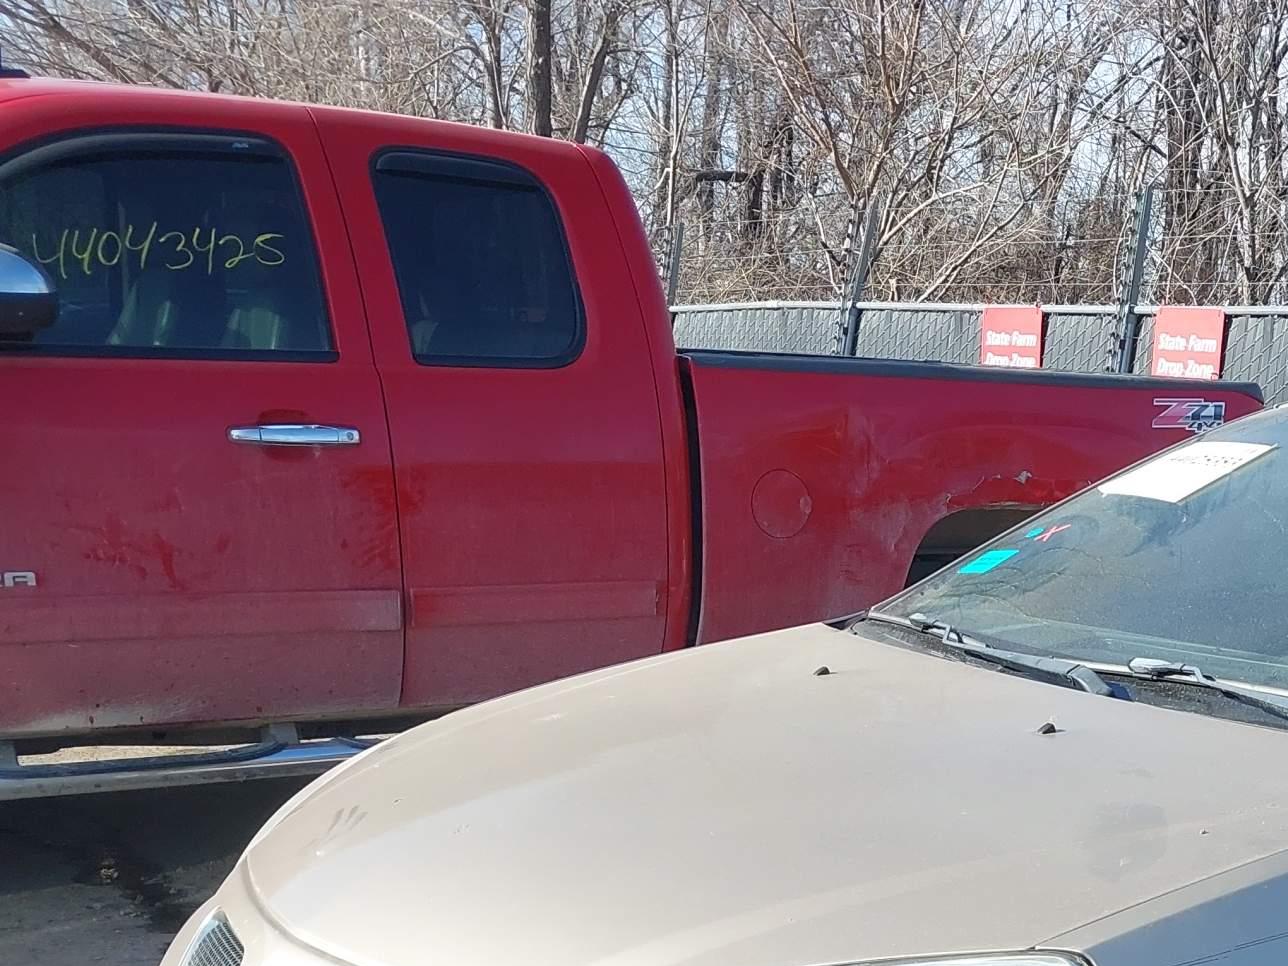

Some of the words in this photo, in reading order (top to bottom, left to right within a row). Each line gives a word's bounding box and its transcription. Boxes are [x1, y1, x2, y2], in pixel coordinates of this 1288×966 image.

[32, 221, 286, 279] 44043425
[985, 330, 1010, 347] State
[1011, 331, 1037, 347] Farm
[1158, 333, 1186, 351] State
[1189, 335, 1217, 353] Farm
[1156, 357, 1184, 376] Drop
[1185, 360, 1215, 379] Zone
[1152, 398, 1225, 428] Z71
